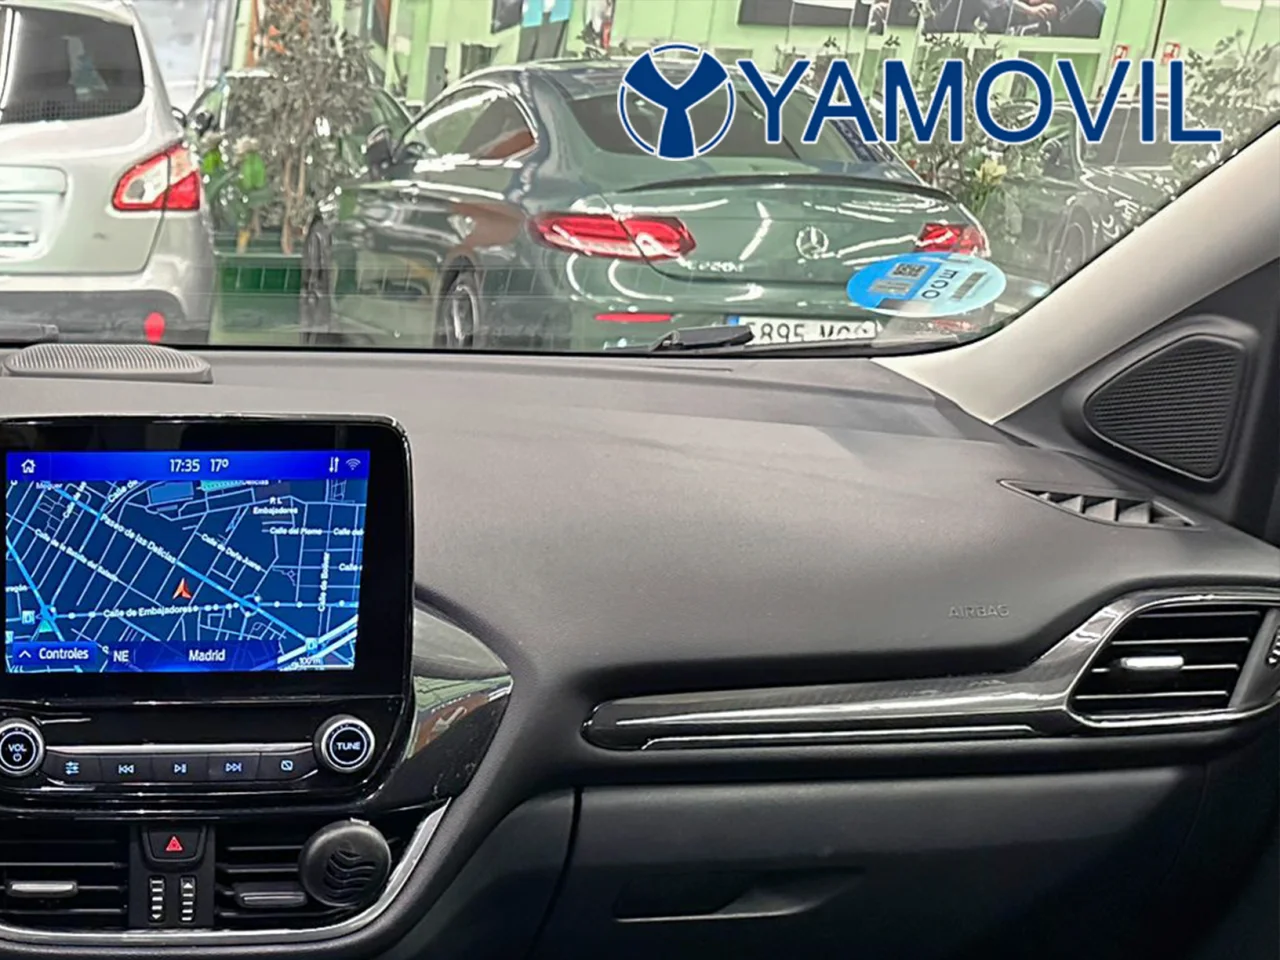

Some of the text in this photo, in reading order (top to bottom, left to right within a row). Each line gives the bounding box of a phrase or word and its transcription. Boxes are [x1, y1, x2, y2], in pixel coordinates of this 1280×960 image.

[921, 269, 959, 300] ECO
[170, 459, 200, 472] 17:35
[253, 507, 298, 515] Embajadores
[270, 527, 287, 535] Calle
[333, 527, 350, 535] Calle
[100, 513, 176, 564] Paseo de las Delicias
[103, 605, 192, 618] Calle de Embajadores
[948, 603, 1010, 618] AIRBAG
[39, 647, 89, 660] Controles
[113, 650, 129, 662] NE
[189, 649, 226, 662] Madrid
[7, 743, 27, 753] VOL
[336, 741, 361, 750] TUNE
